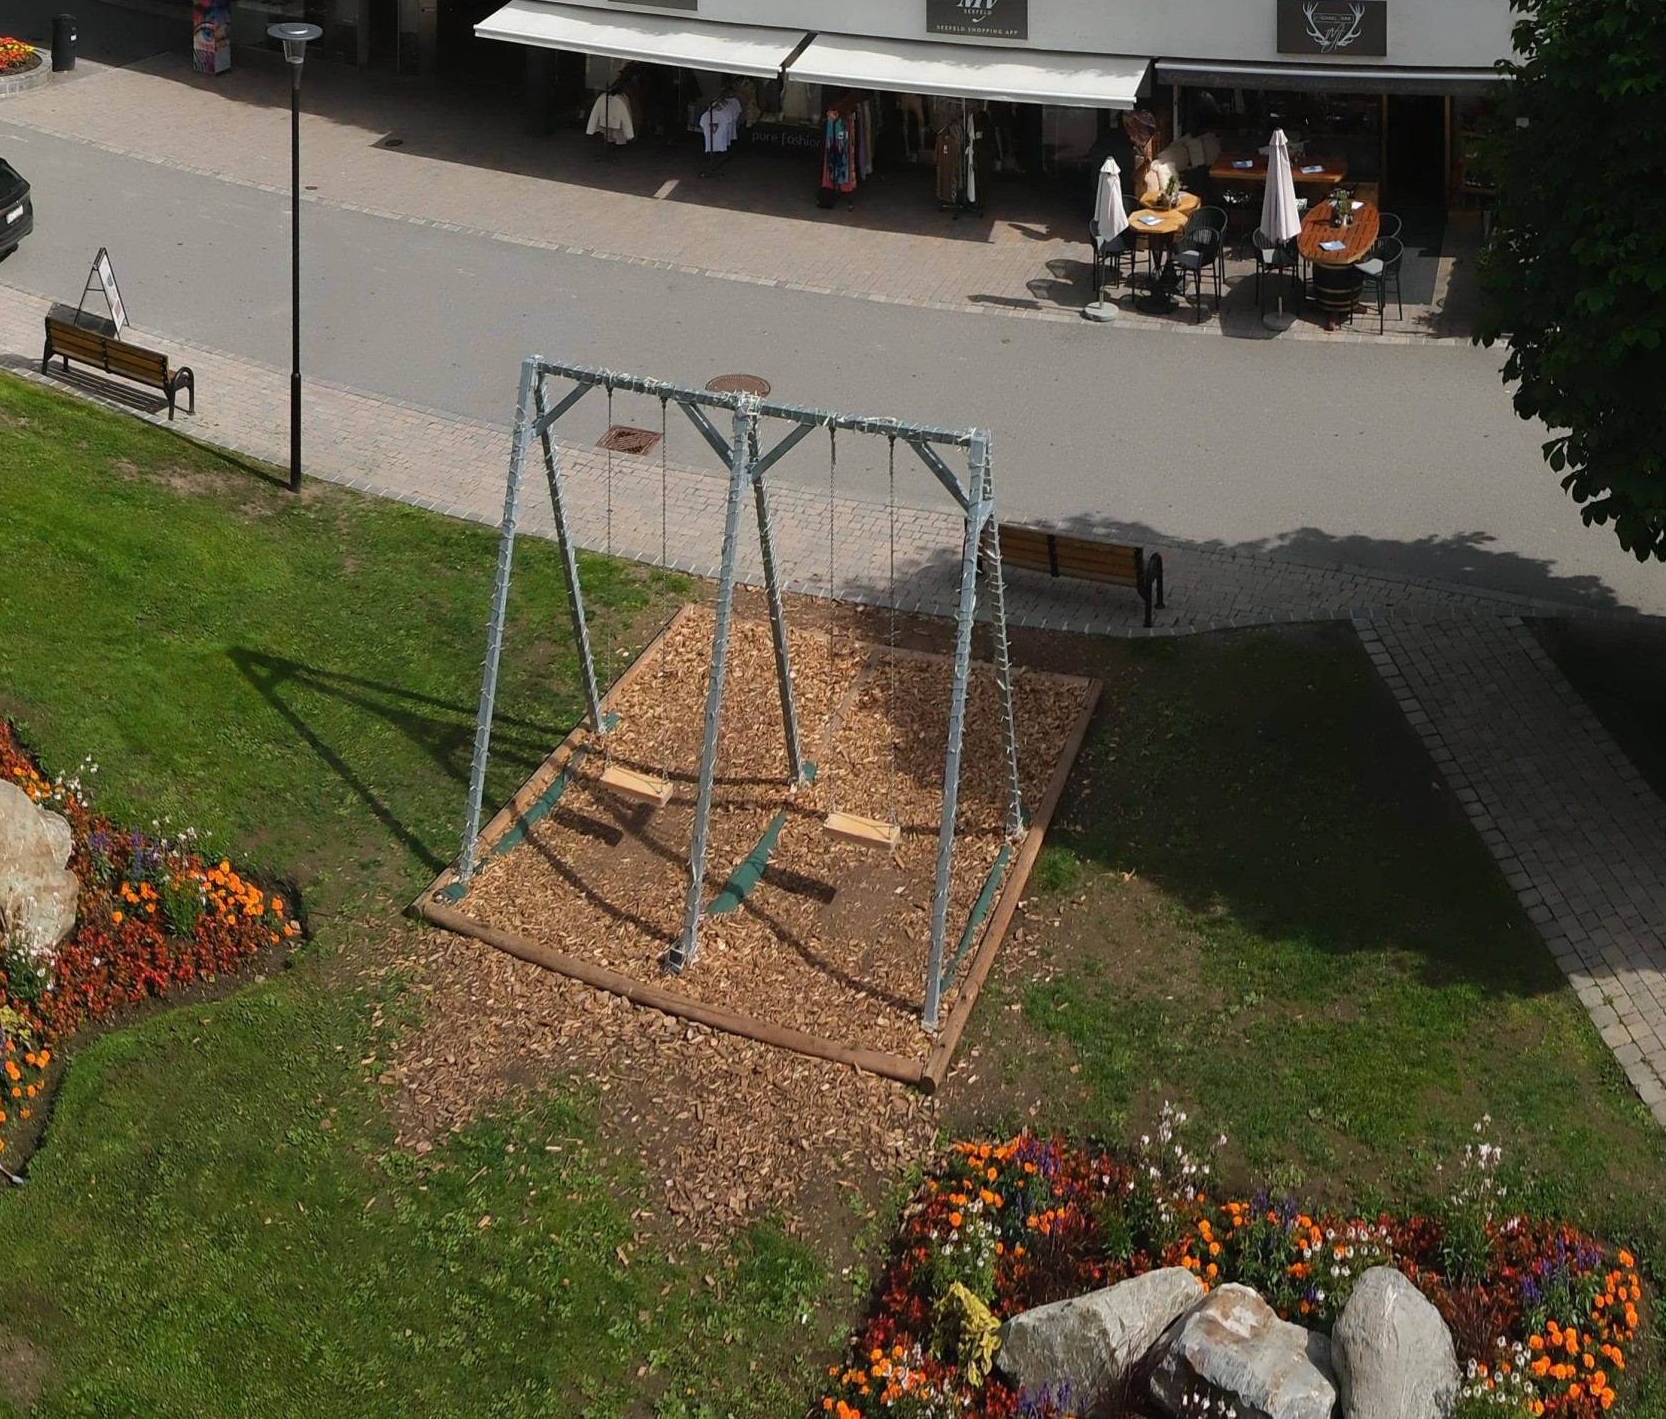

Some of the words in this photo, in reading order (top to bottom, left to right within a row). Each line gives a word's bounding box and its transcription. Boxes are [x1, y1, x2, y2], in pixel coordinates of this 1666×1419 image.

[936, 24, 965, 32] SEEFELD
[968, 26, 1003, 35] SHOPPING
[752, 131, 778, 143] pure
